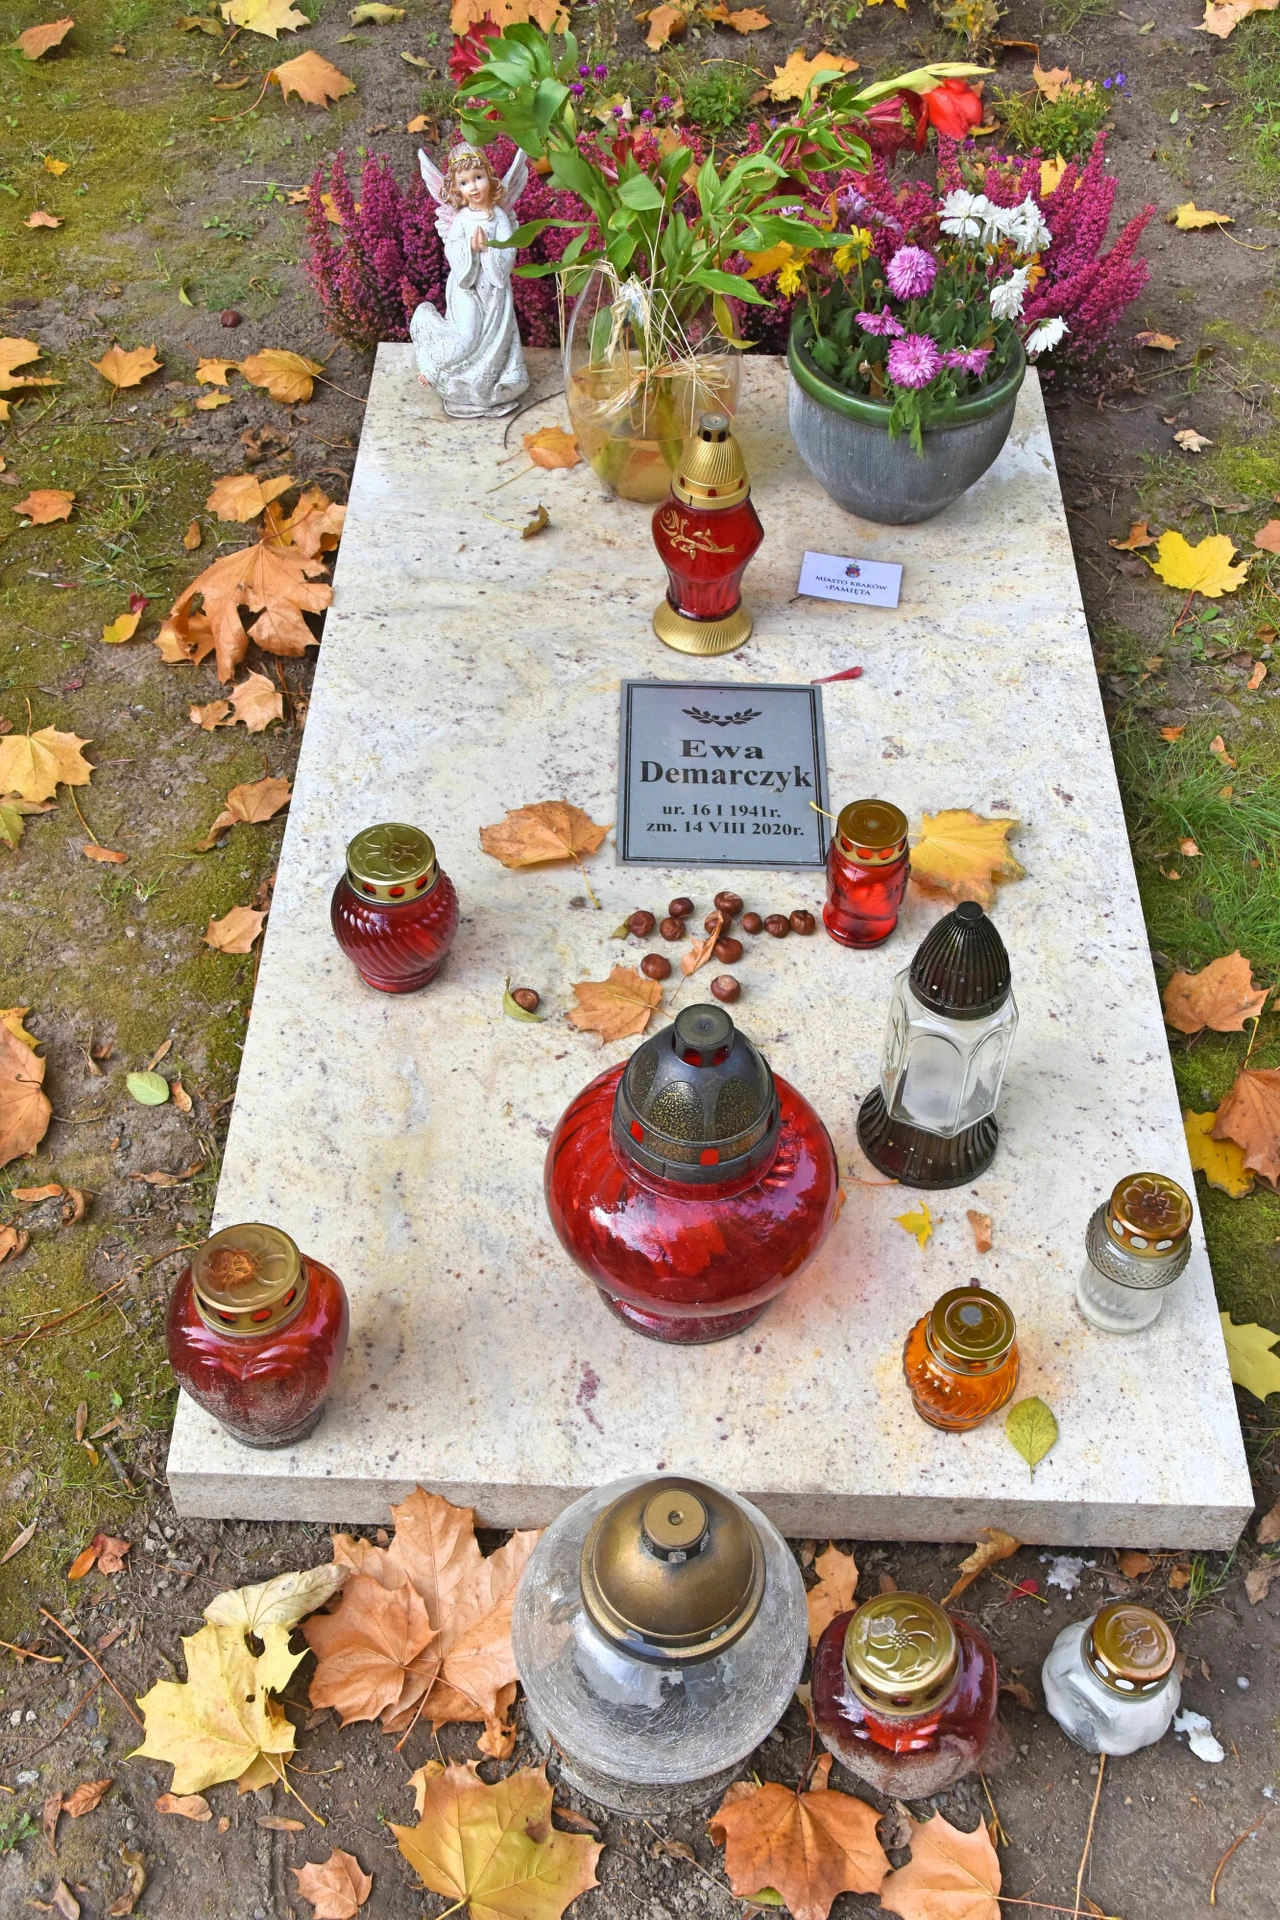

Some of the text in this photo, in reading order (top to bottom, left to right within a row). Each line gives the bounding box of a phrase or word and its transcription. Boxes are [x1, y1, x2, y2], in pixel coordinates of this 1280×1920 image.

[816, 576, 847, 585] MIASTO
[829, 585, 871, 595] PAMIĘTA
[680, 739, 764, 759] Ewa
[639, 761, 812, 792] Demarczyk
[662, 804, 781, 817] ur. 16 I 1941r.
[646, 822, 804, 836] zm. 14 VIII 2020r.
